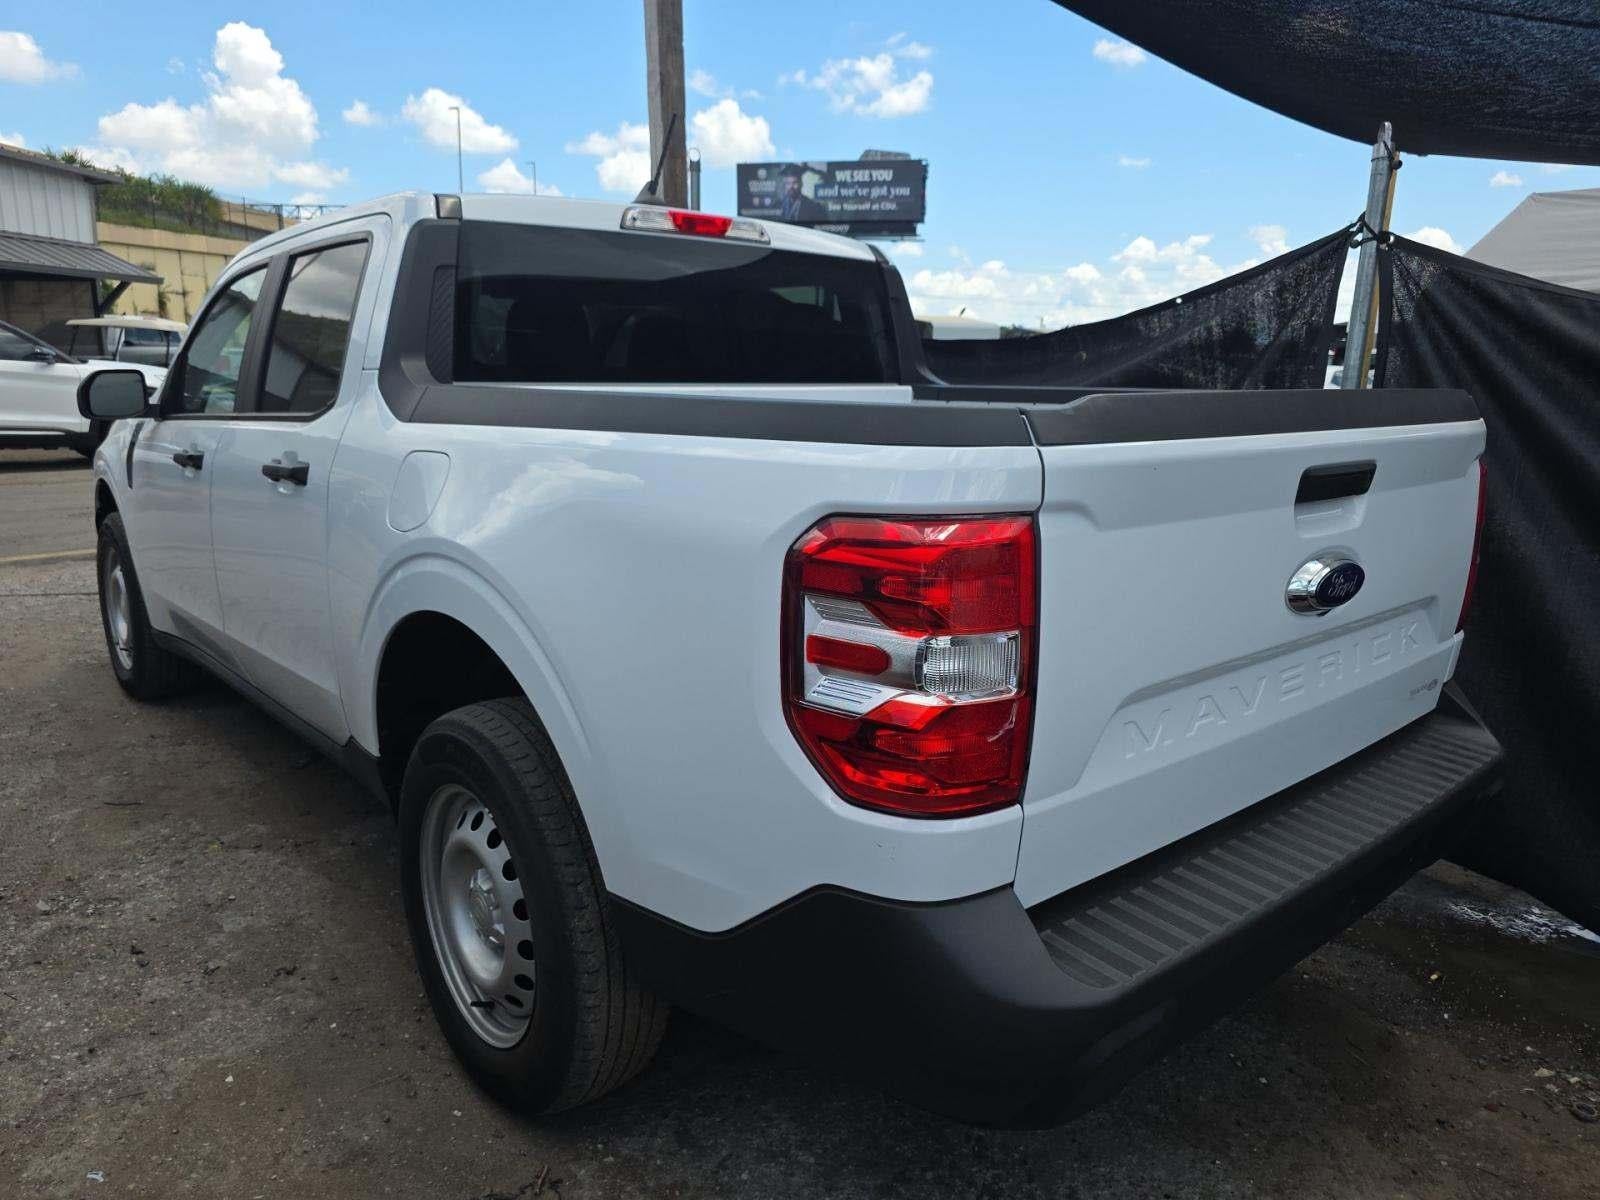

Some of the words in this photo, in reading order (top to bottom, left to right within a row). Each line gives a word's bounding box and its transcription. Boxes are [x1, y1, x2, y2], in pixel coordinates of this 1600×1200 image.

[852, 169, 870, 182] SEE
[871, 168, 893, 181] YOU
[817, 184, 839, 197] and
[840, 185, 869, 197] we've
[870, 185, 887, 199] got
[889, 187, 910, 199] you
[1328, 572, 1358, 598] Ford
[1122, 620, 1421, 760] MAVERICK
